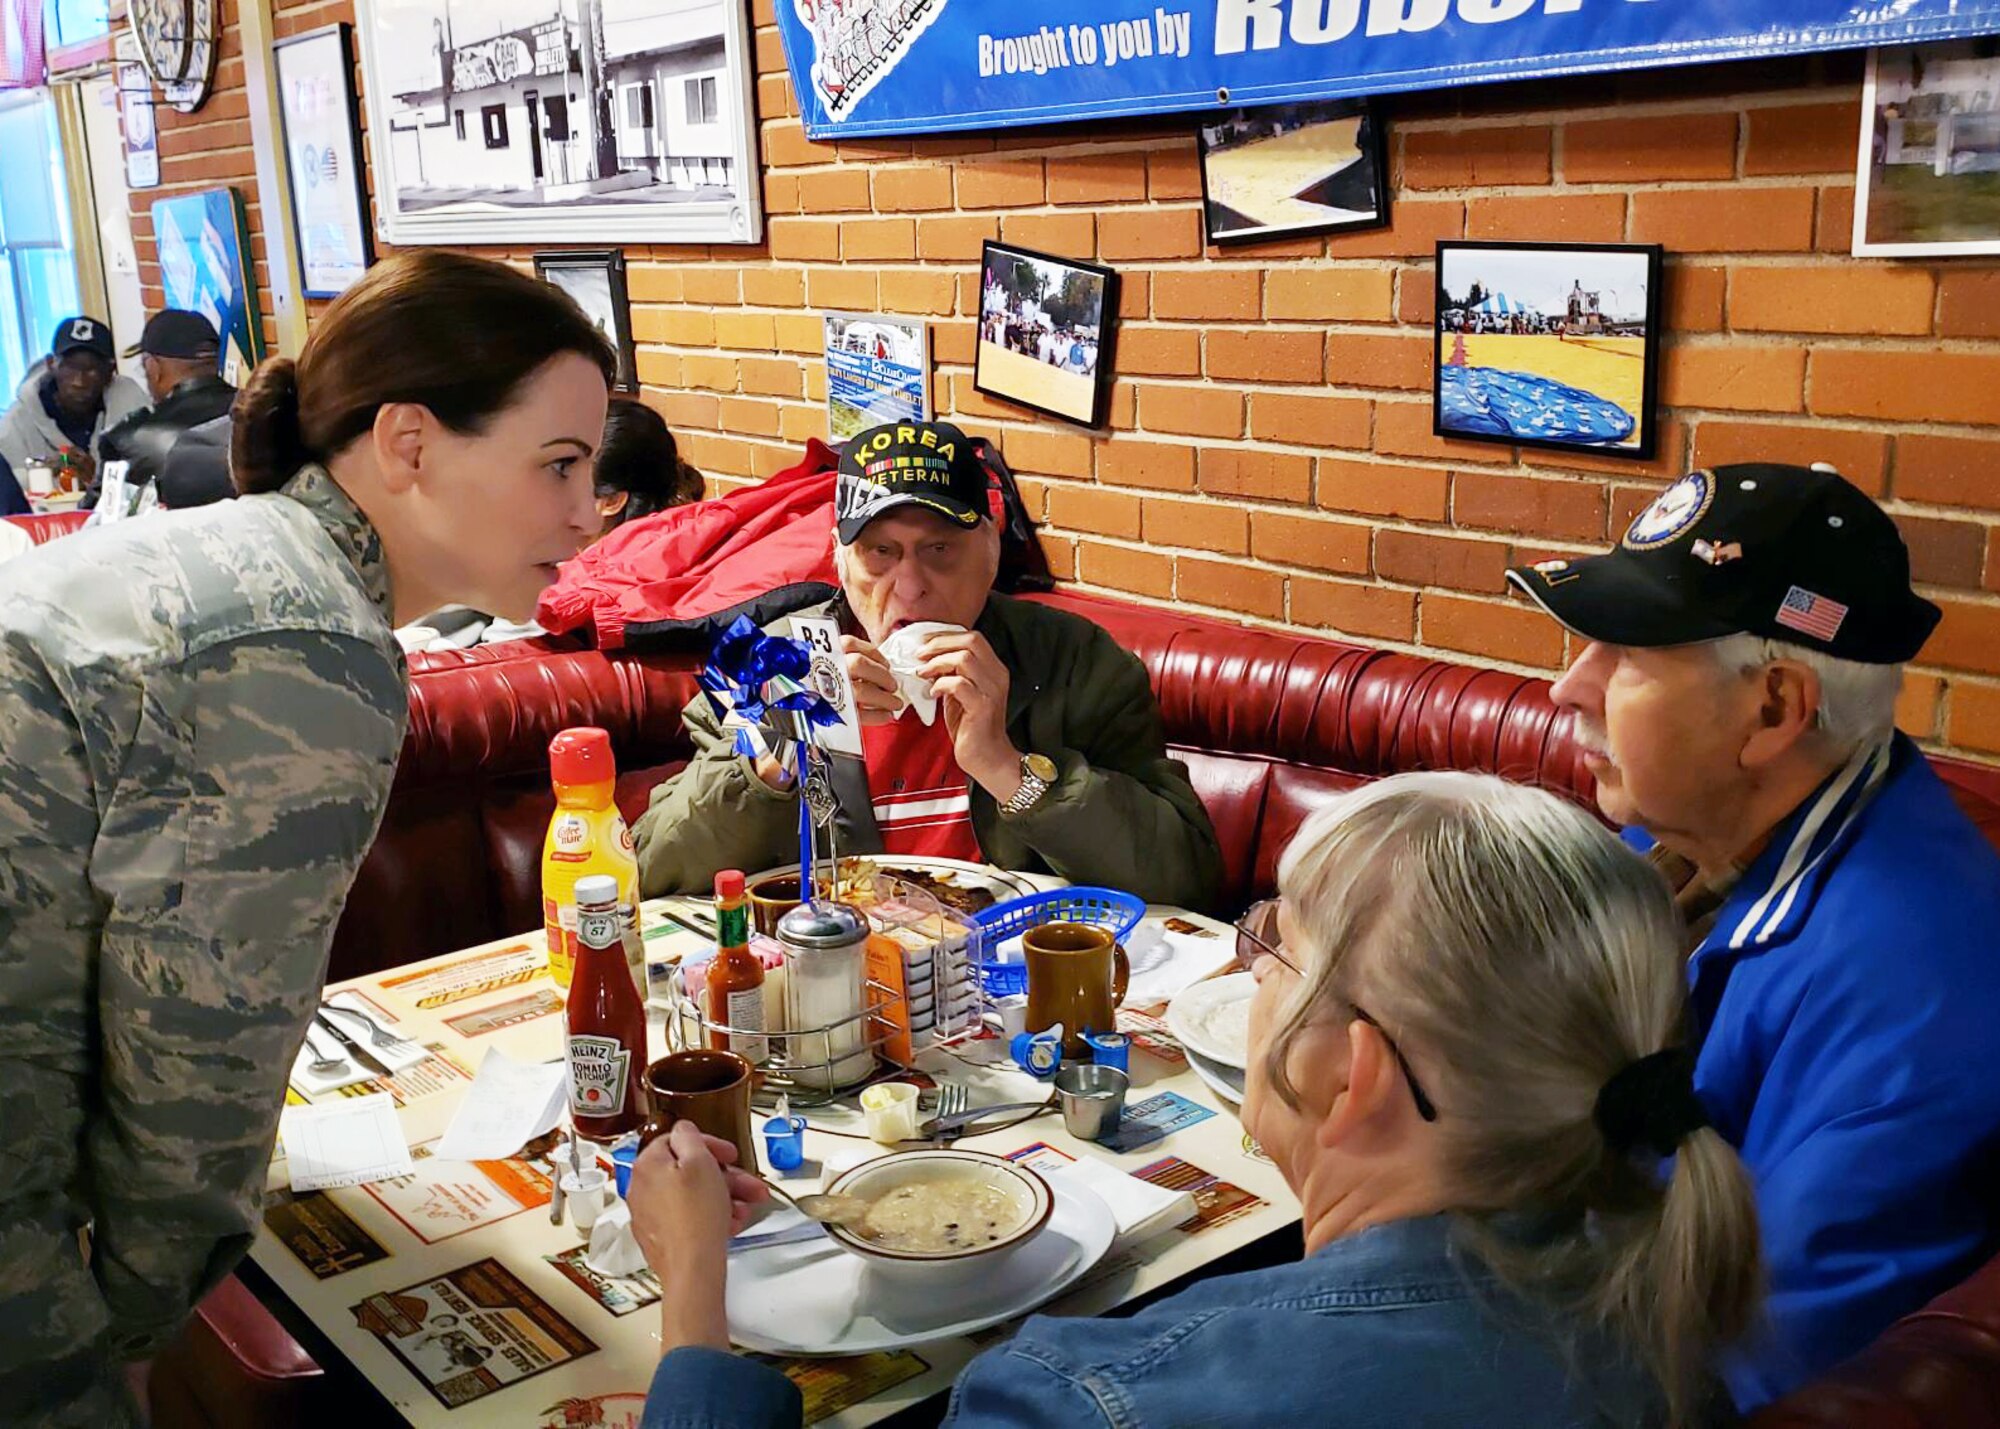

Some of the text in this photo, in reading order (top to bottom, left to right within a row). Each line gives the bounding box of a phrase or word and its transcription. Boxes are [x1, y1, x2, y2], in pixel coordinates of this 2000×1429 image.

[978, 25, 1071, 78] Brought
[1068, 24, 1098, 65] to
[1100, 18, 1153, 67] you
[1155, 7, 1191, 58] by
[854, 426, 955, 468] KOREA
[866, 467, 950, 487] VETERAN
[590, 926, 606, 936] 57
[571, 1045, 607, 1059] HEINZ
[572, 1061, 612, 1074] TOMATO
[574, 1070, 611, 1081] KETCHUP
